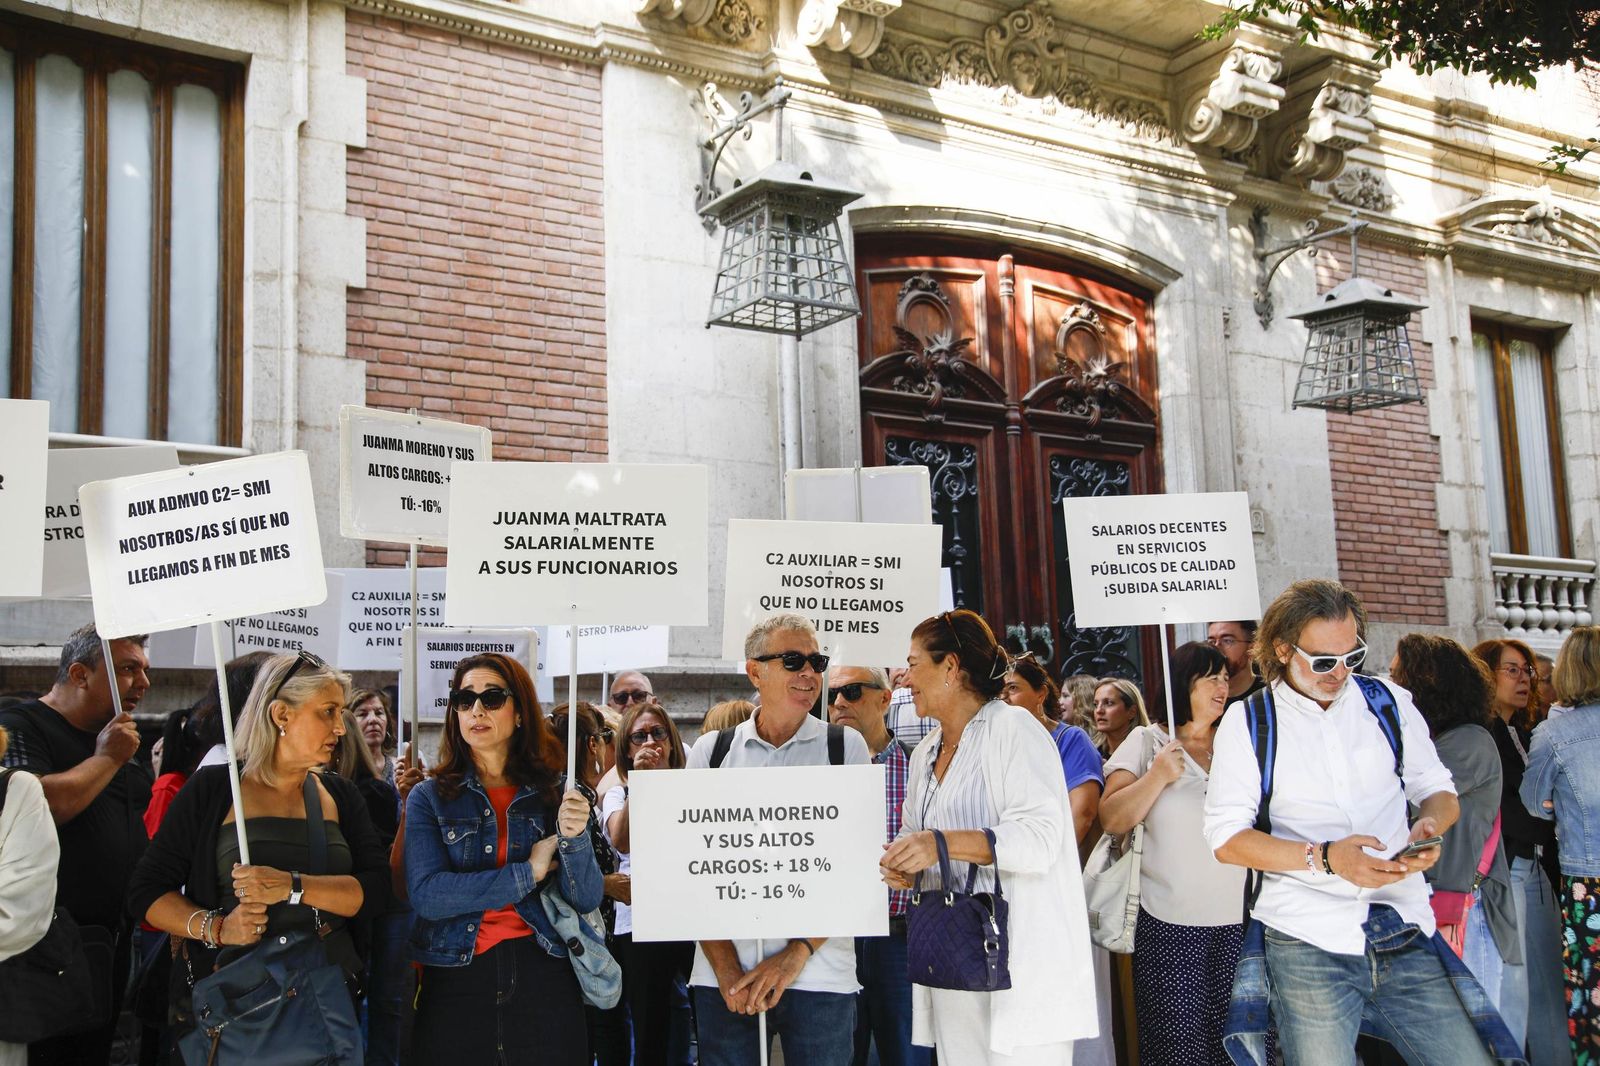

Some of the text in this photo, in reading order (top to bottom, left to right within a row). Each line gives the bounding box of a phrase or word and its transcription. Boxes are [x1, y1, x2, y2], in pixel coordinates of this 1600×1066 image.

[363, 434, 474, 461] JUANMA MORENO Y SUS
[368, 463, 399, 479] ALTOS
[402, 468, 443, 484] CARGOS:
[128, 500, 156, 517] AUX
[159, 491, 208, 512] ADMVO
[243, 480, 271, 497] SMI
[401, 496, 441, 513] TÚ: -16%
[493, 512, 666, 526] JUANMA MALTRATA
[119, 512, 289, 554] NOSOTROS/AS SÍ QUE NO
[1092, 521, 1227, 536] SALARIOS DECENTES
[504, 536, 654, 550] SALARIALMENTE
[1117, 541, 1206, 555] EN SERVICIOS
[128, 544, 290, 585] LLEGAMOS A FIN DE MES
[479, 561, 678, 575] A SUS FUNCIONARIOS
[766, 553, 784, 565] C2
[788, 554, 857, 568] AUXILIAR
[874, 557, 901, 569] SMI
[1091, 559, 1236, 575] PÚBLICOS DE CALIDAD
[782, 575, 883, 590] NOSOTROS SI
[1104, 579, 1227, 597] ¡SUBIDA SALARIAL!
[352, 592, 365, 600] C2
[760, 596, 903, 613] QUE NO LLEGAMOS
[249, 618, 263, 628] NO
[267, 621, 319, 636] LLEGAMOS
[349, 622, 372, 633] QUE
[376, 622, 392, 631] NO
[566, 626, 606, 638] NESTRO
[824, 620, 843, 632] DE
[848, 621, 879, 633] MES
[238, 634, 303, 650] A FIN DE MES
[366, 638, 373, 646] A
[427, 642, 514, 652] SALARIOS DECENTES EN
[678, 805, 839, 823] JUANMA MORENO
[703, 832, 814, 848] Y SUS ALTOS
[688, 859, 768, 874] CARGOS:
[716, 882, 745, 900] TÚ:
